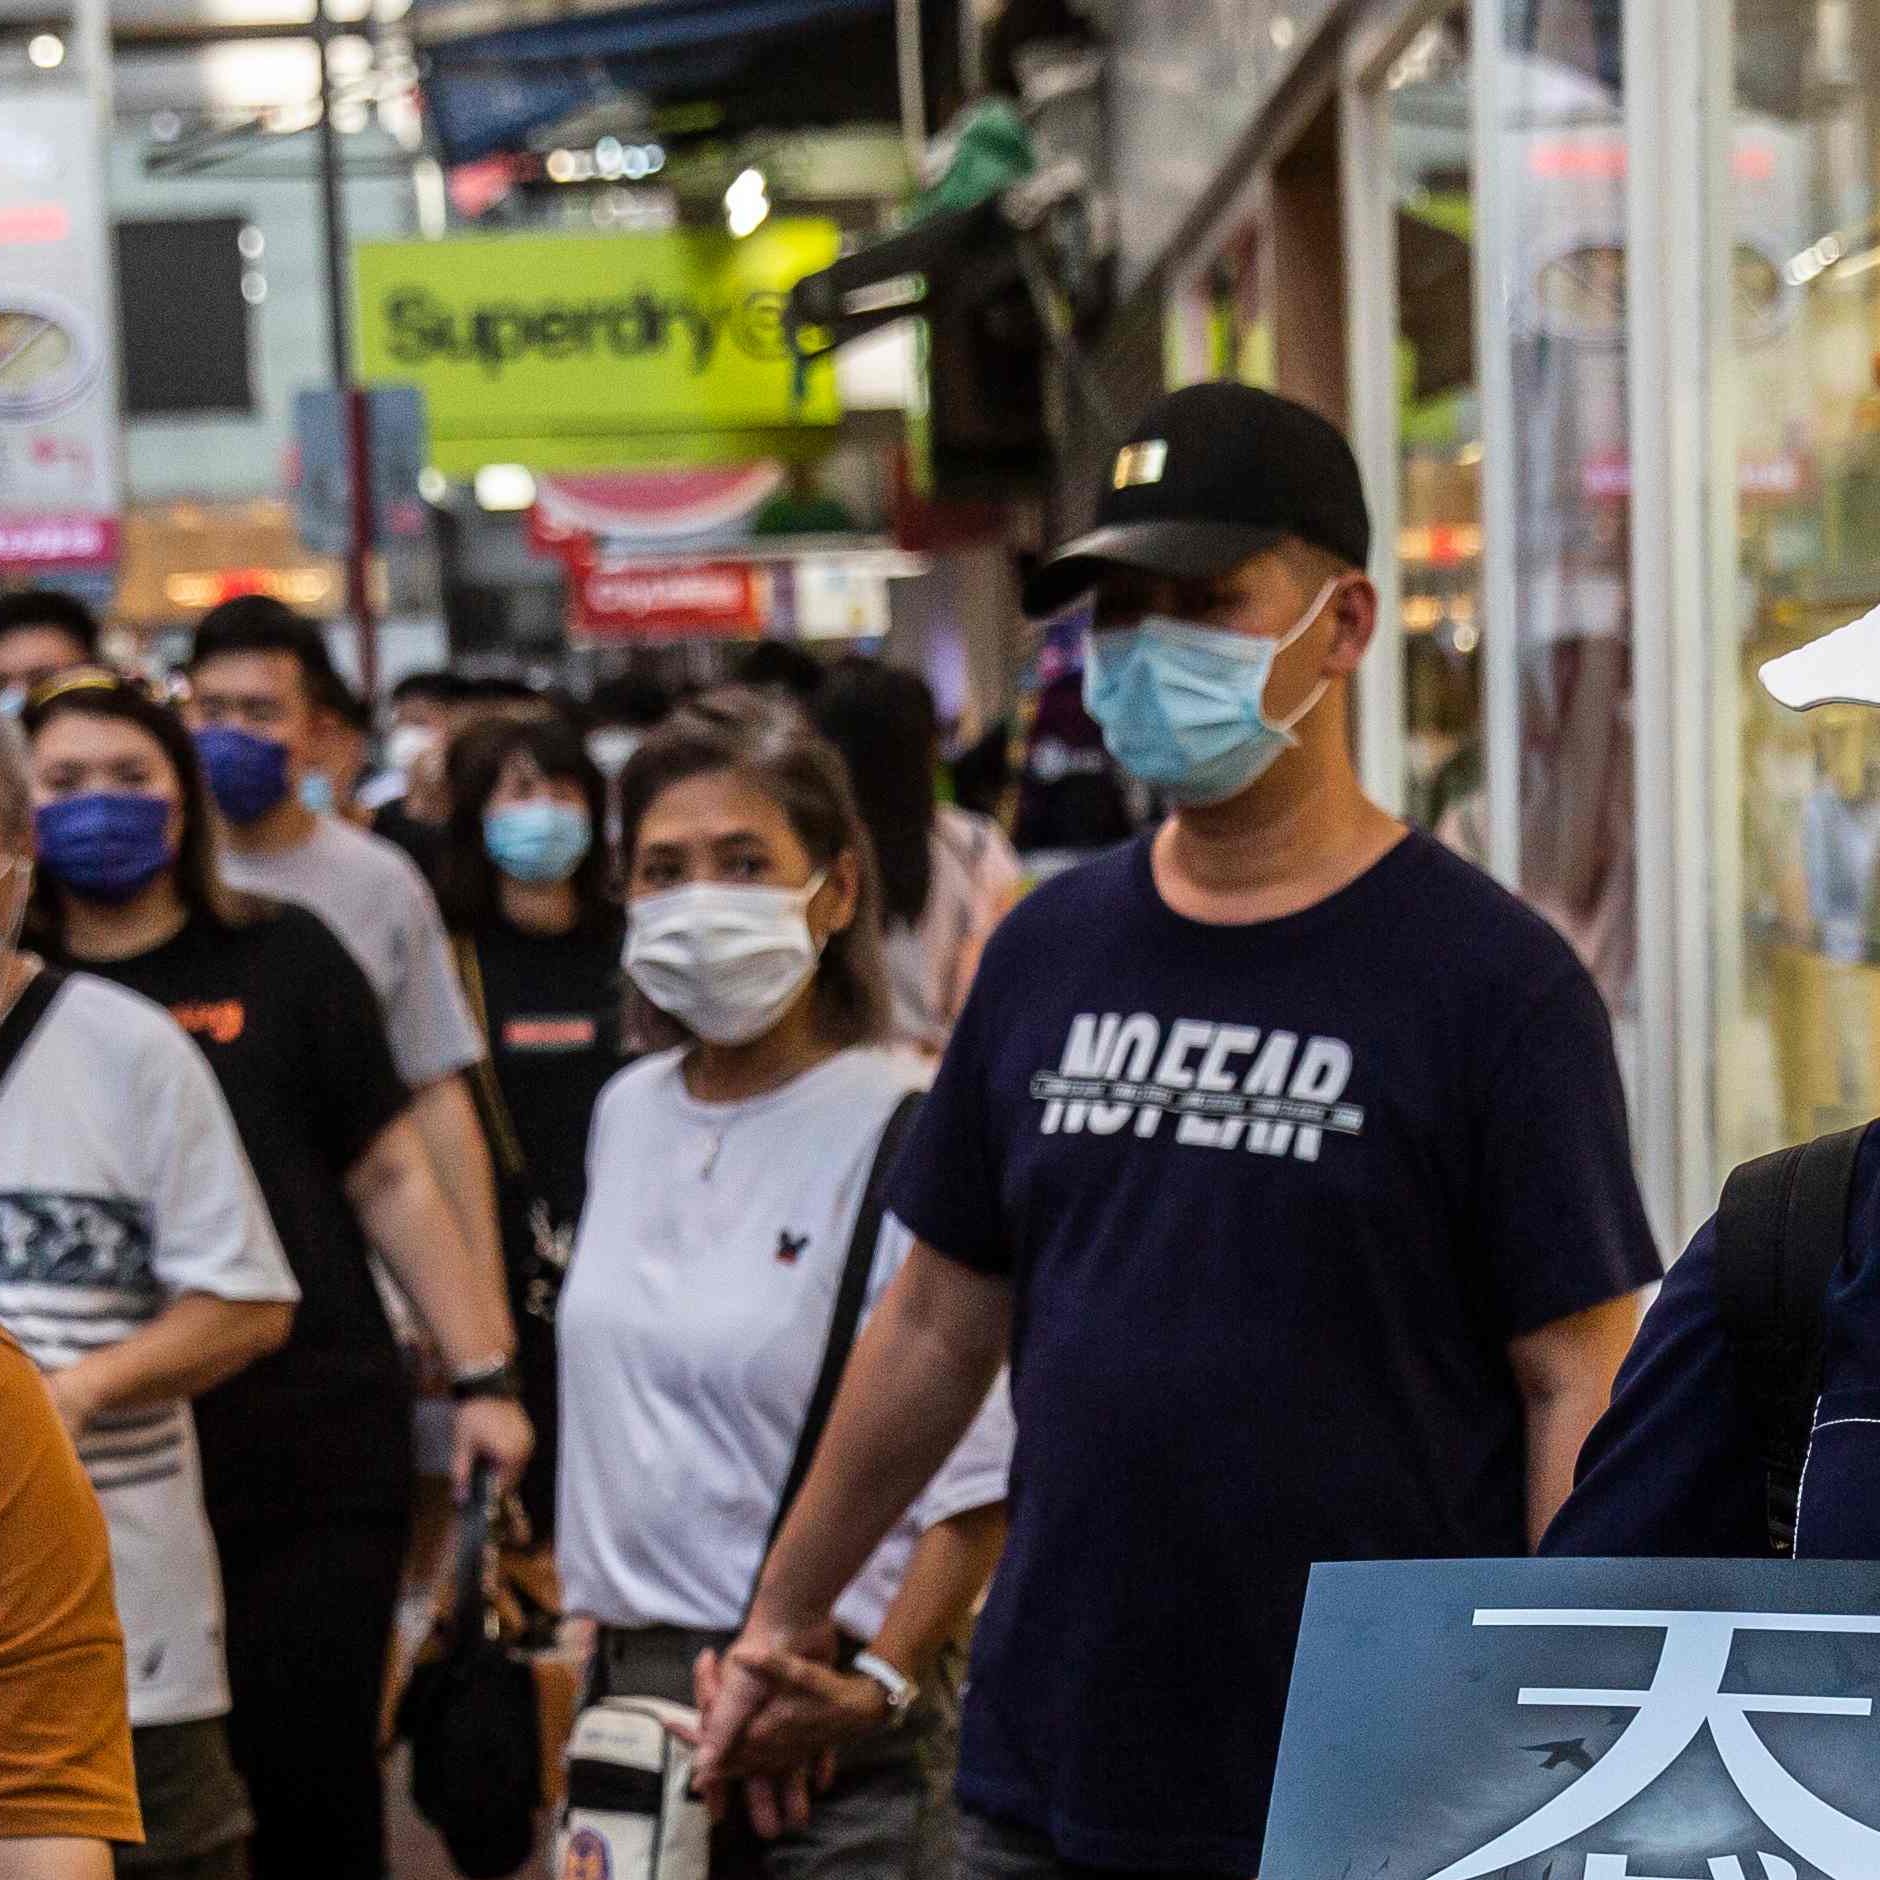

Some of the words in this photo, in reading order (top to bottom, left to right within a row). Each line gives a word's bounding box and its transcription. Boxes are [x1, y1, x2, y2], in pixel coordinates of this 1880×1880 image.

[386, 283, 720, 380] Superdry
[1040, 1012, 1161, 1137] NO
[1133, 1018, 1353, 1163] FEAR
